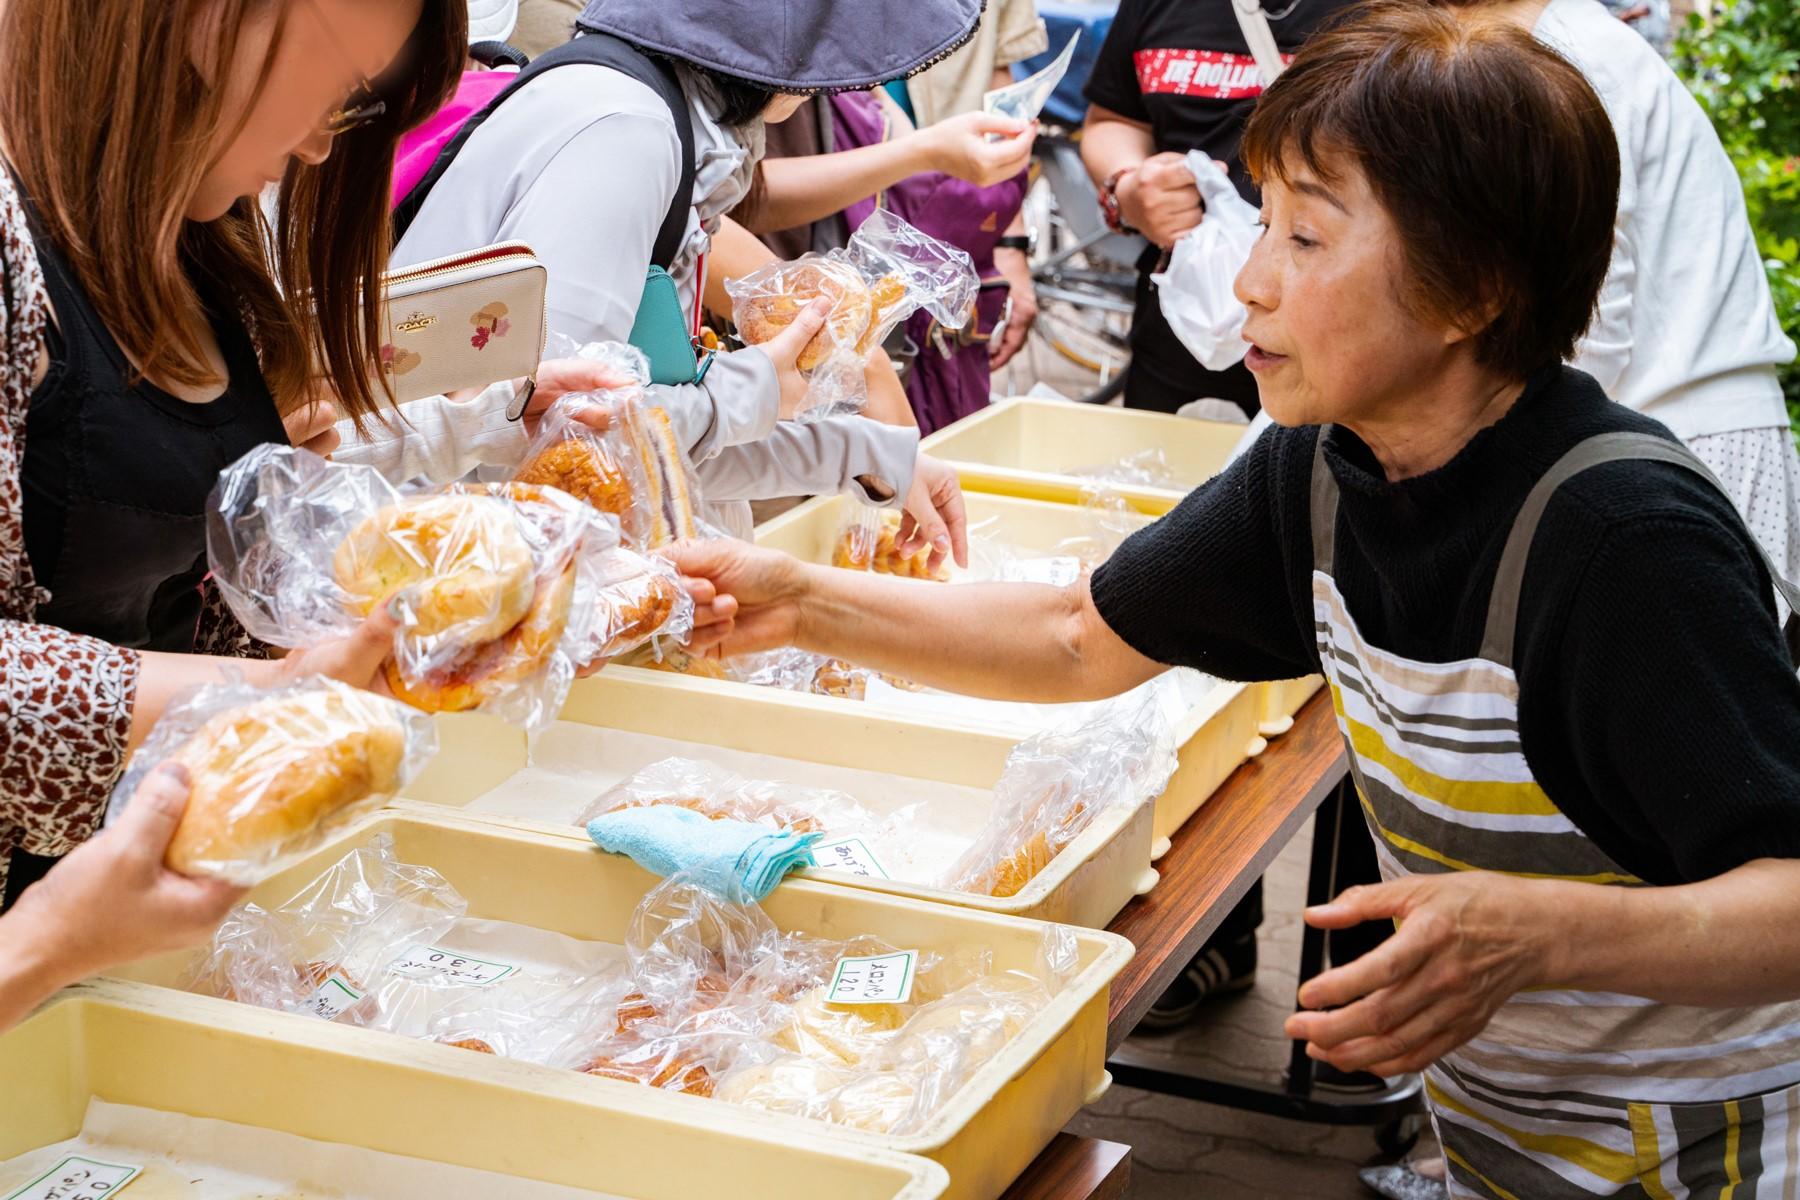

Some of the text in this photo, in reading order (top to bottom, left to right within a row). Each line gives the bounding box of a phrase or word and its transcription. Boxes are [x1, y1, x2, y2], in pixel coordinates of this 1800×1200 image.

[396, 316, 438, 331] COACH
[429, 953, 482, 971] 130
[837, 970, 861, 992] 120
[863, 963, 889, 998] メロンパン
